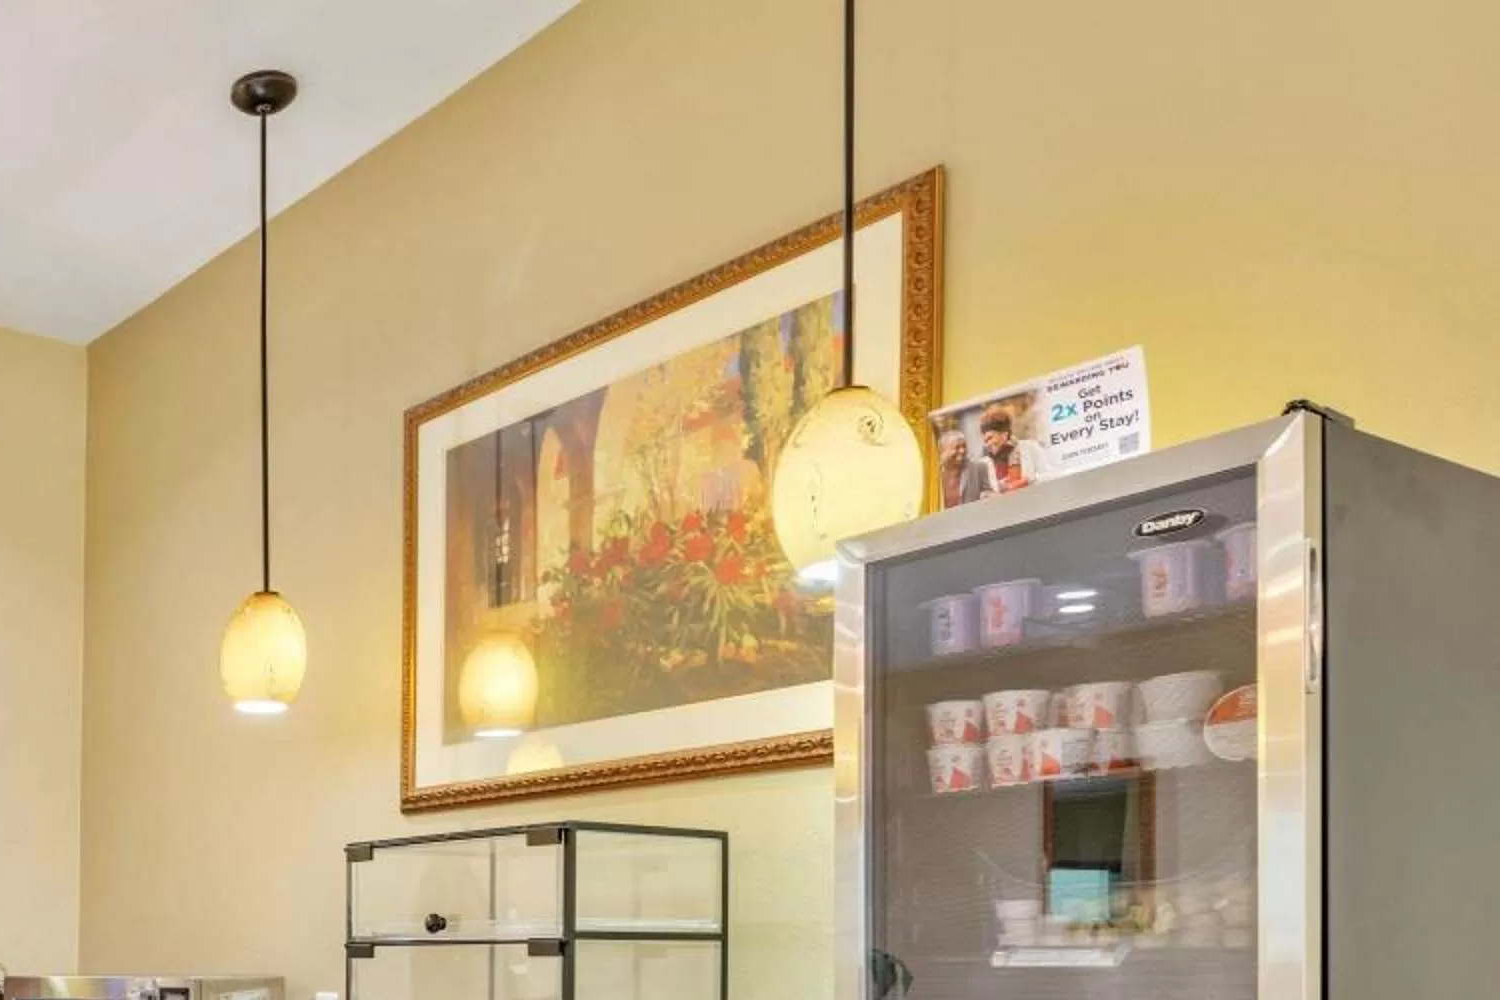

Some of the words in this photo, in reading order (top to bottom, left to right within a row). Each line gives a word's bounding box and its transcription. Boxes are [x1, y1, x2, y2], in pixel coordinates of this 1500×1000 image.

[1078, 384, 1101, 399] Get
[1050, 403, 1078, 423] 2x
[1083, 389, 1134, 412] Points
[1084, 411, 1102, 423] on
[1050, 425, 1094, 445] Every
[1099, 409, 1140, 431] Stay!
[1142, 511, 1200, 534] Danby
